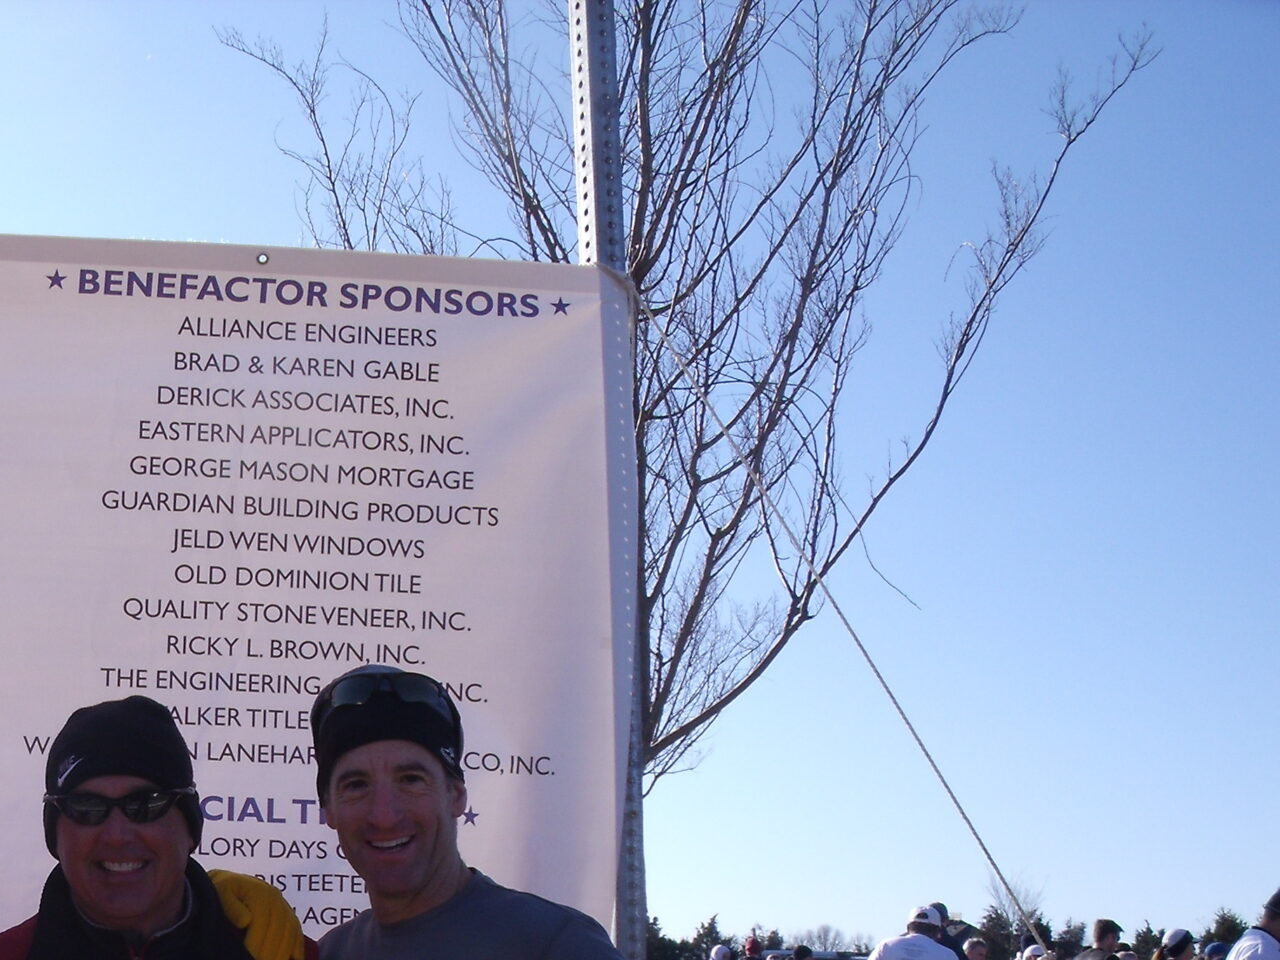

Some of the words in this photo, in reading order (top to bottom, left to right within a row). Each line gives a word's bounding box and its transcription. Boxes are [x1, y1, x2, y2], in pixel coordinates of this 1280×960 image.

[78, 269, 328, 308] BENEFACTOR
[339, 283, 539, 319] SPONSORS
[178, 316, 296, 342] ALLIANCE
[305, 323, 437, 348] ENGINEERS
[174, 352, 240, 373] BRAD
[248, 355, 264, 374] &
[272, 356, 355, 378] KAREN
[363, 360, 440, 383] GABLE
[157, 386, 245, 408] DERICK
[252, 390, 399, 418] ASSOCIATES,
[406, 398, 454, 420] INC.
[139, 421, 245, 444] EASTERN
[250, 426, 414, 454] APPLICATORS,
[420, 434, 470, 456] INC.
[129, 456, 231, 479] GEORGE
[240, 461, 328, 484] MASON
[337, 466, 474, 491] MORTGAGE
[102, 490, 234, 514] GUARDIAN
[243, 496, 359, 522] BUILDING
[367, 503, 499, 527] PRODUCTS
[171, 528, 224, 553] JELD
[230, 531, 288, 552] WEN
[293, 534, 425, 559] WINDOWS
[174, 564, 226, 585] OLD
[235, 567, 369, 592] DOMINION
[375, 572, 421, 594] TILE
[123, 597, 230, 622] QUALITY
[237, 603, 317, 625] STONE
[320, 606, 416, 631] VENEER,
[421, 610, 471, 632] INC.
[166, 635, 237, 657] RICKY
[247, 639, 263, 658] L.
[270, 640, 369, 665] BROWN,
[376, 644, 425, 665] INC.
[101, 667, 147, 688] THE
[155, 670, 320, 695] ENGINEERING
[442, 682, 487, 703] NC.
[167, 706, 241, 727] ALKER
[247, 709, 308, 730] TITLE
[208, 742, 317, 765] LANEHAR
[511, 755, 555, 776] INC.
[200, 796, 286, 824] CIAL
[193, 837, 261, 859] LORY
[269, 840, 327, 859] DAYS
[292, 874, 368, 893] TEETE
